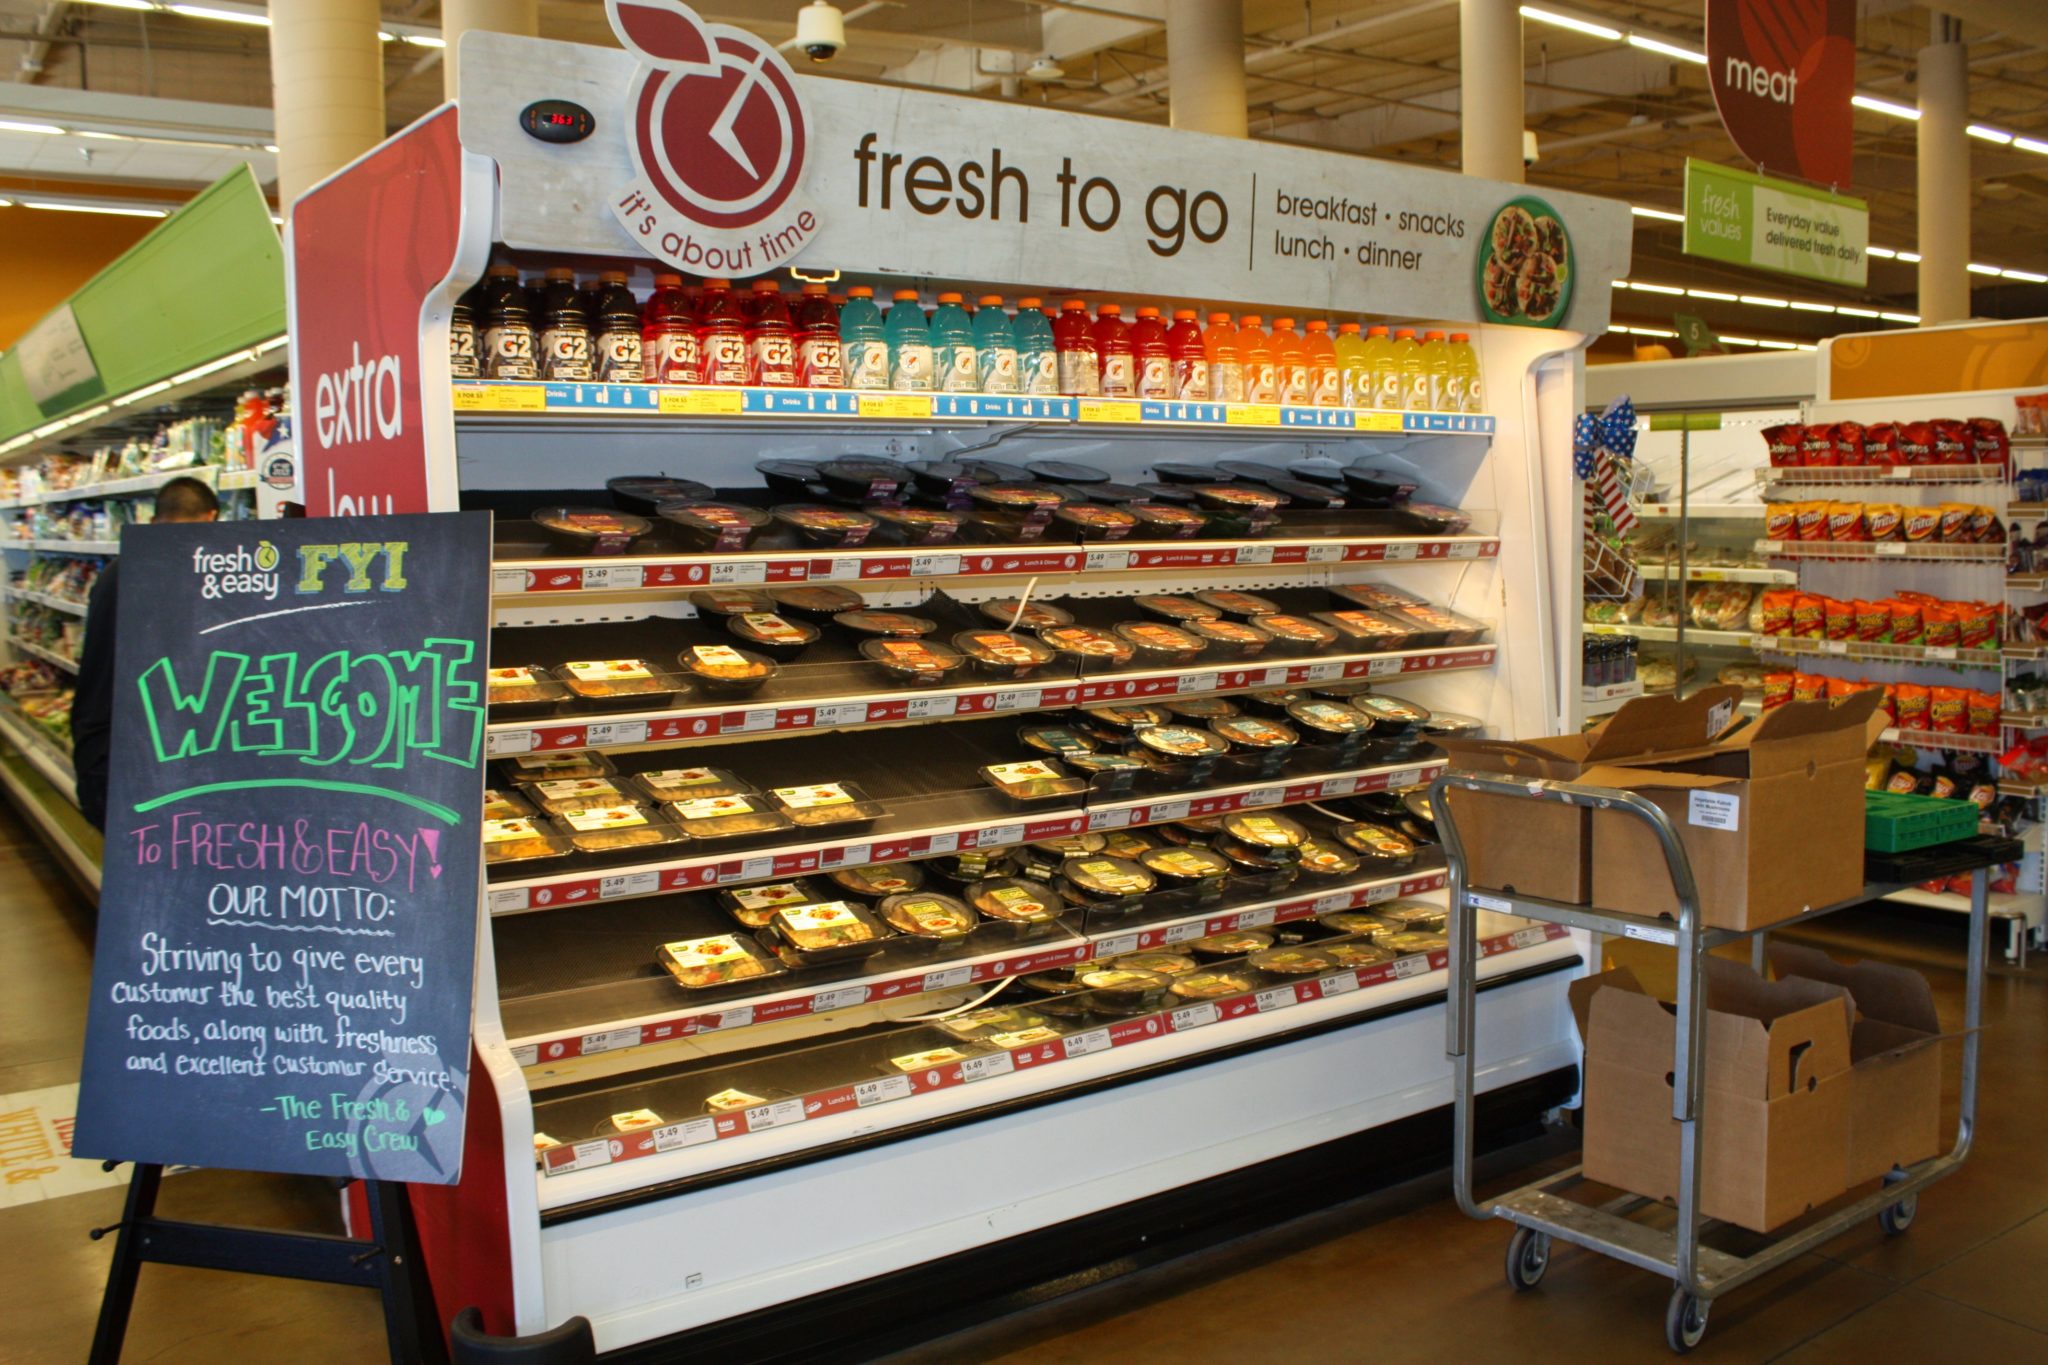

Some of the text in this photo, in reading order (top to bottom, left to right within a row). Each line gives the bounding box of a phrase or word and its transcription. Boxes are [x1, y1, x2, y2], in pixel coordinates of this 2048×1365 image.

[1726, 55, 1798, 105] meat
[853, 132, 1229, 257] fresh to go
[1702, 184, 1740, 219] fresh
[1276, 188, 1465, 238] breakfast snacks
[1766, 207, 1840, 237] Everyday value
[618, 189, 816, 270] it's about time
[1700, 217, 1742, 241] values
[1275, 229, 1422, 270] lunch dinner
[1766, 230, 1812, 252] delivered
[1813, 239, 1836, 257] fresh
[498, 334, 532, 358] G2
[553, 336, 588, 360] G2
[609, 339, 641, 362] G2
[669, 342, 696, 363] G2
[715, 342, 745, 363] G2
[761, 343, 792, 364] G2
[811, 347, 840, 368] G2
[863, 350, 884, 371] G
[900, 351, 920, 371] G
[955, 354, 974, 374] G
[995, 355, 1013, 376] G
[1040, 357, 1055, 379] G
[1106, 358, 1124, 379] G
[1145, 361, 1164, 383] G
[1192, 364, 1207, 385] G
[1260, 367, 1274, 388] G
[1291, 370, 1306, 389] G
[1323, 370, 1338, 391] G
[315, 341, 402, 449] extra
[546, 390, 567, 398] Drinks
[192, 541, 408, 594] fresh FYI
[137, 637, 485, 769] WELCOME
[208, 883, 397, 921] OUR MOTTO:
[141, 932, 424, 989] Striving to give every
[218, 981, 257, 1008] the
[266, 985, 321, 1008] best
[325, 990, 407, 1024] quality
[126, 1014, 438, 1058] foods, along with freshness
[126, 1053, 167, 1074] and
[175, 1053, 265, 1077] excellent
[372, 1059, 457, 1090] Service.
[331, 1092, 391, 1121] Fresh
[828, 1097, 845, 1105] Lunch
[306, 1125, 418, 1158] Easy Crew
